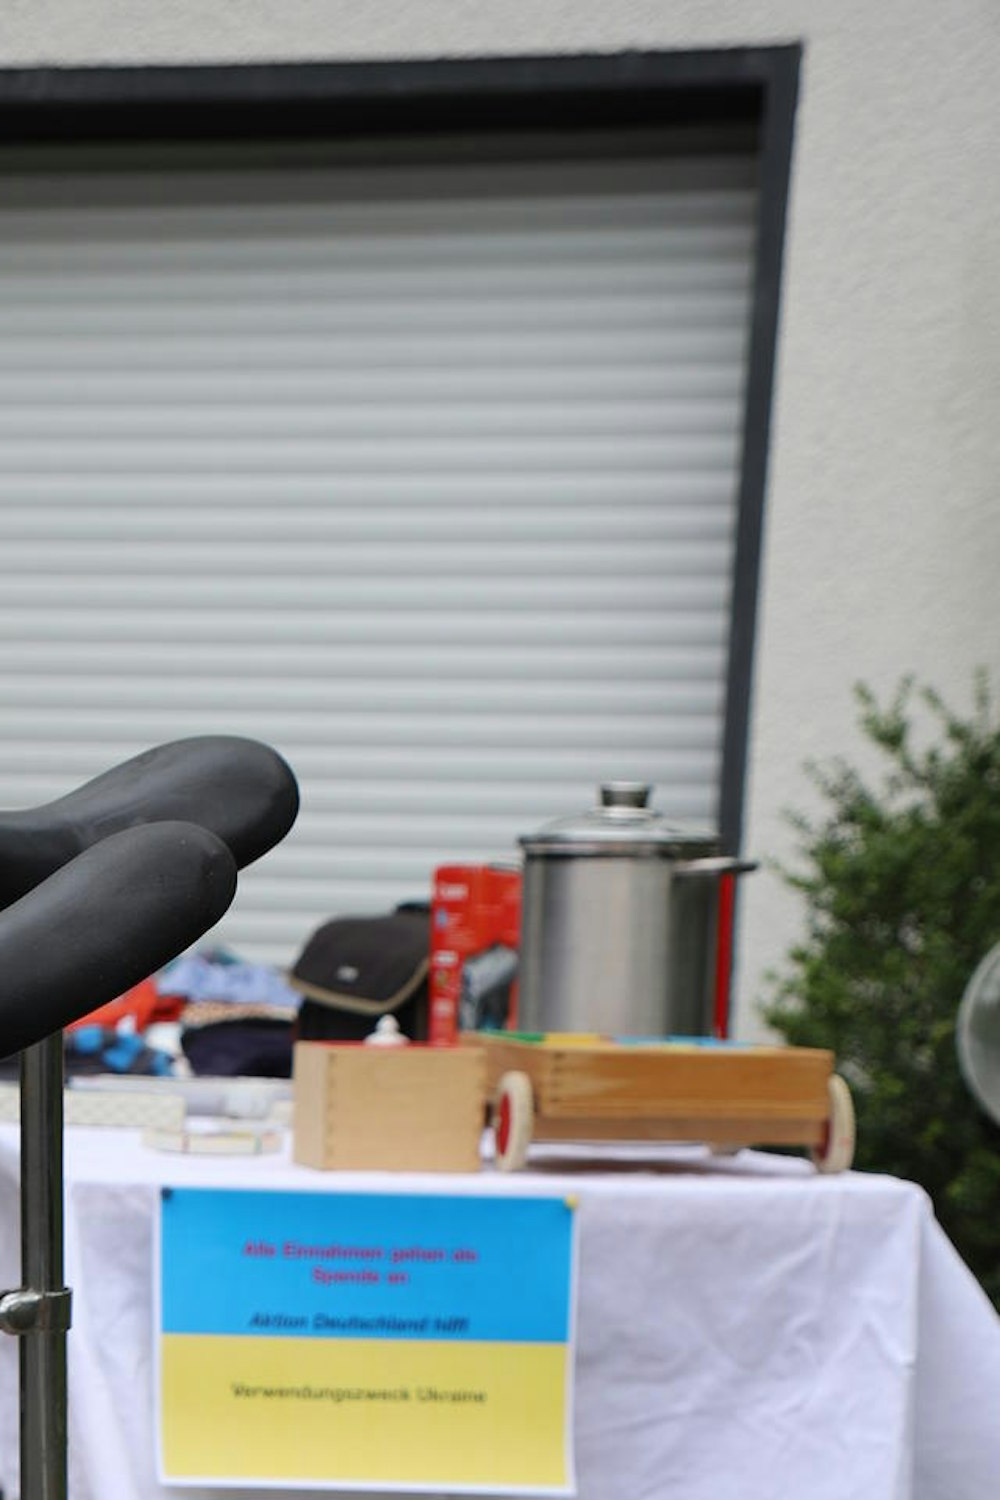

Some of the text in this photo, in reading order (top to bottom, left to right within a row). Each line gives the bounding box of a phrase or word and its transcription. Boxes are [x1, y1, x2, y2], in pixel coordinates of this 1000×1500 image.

[243, 1241, 277, 1257] Alle
[283, 1241, 383, 1260] Einnahmen
[390, 1245, 446, 1264] gehen
[313, 1266, 380, 1285] Spende
[249, 1311, 309, 1328] Aktion
[313, 1313, 428, 1332] Deutschland
[415, 1386, 487, 1403] Ukraine
